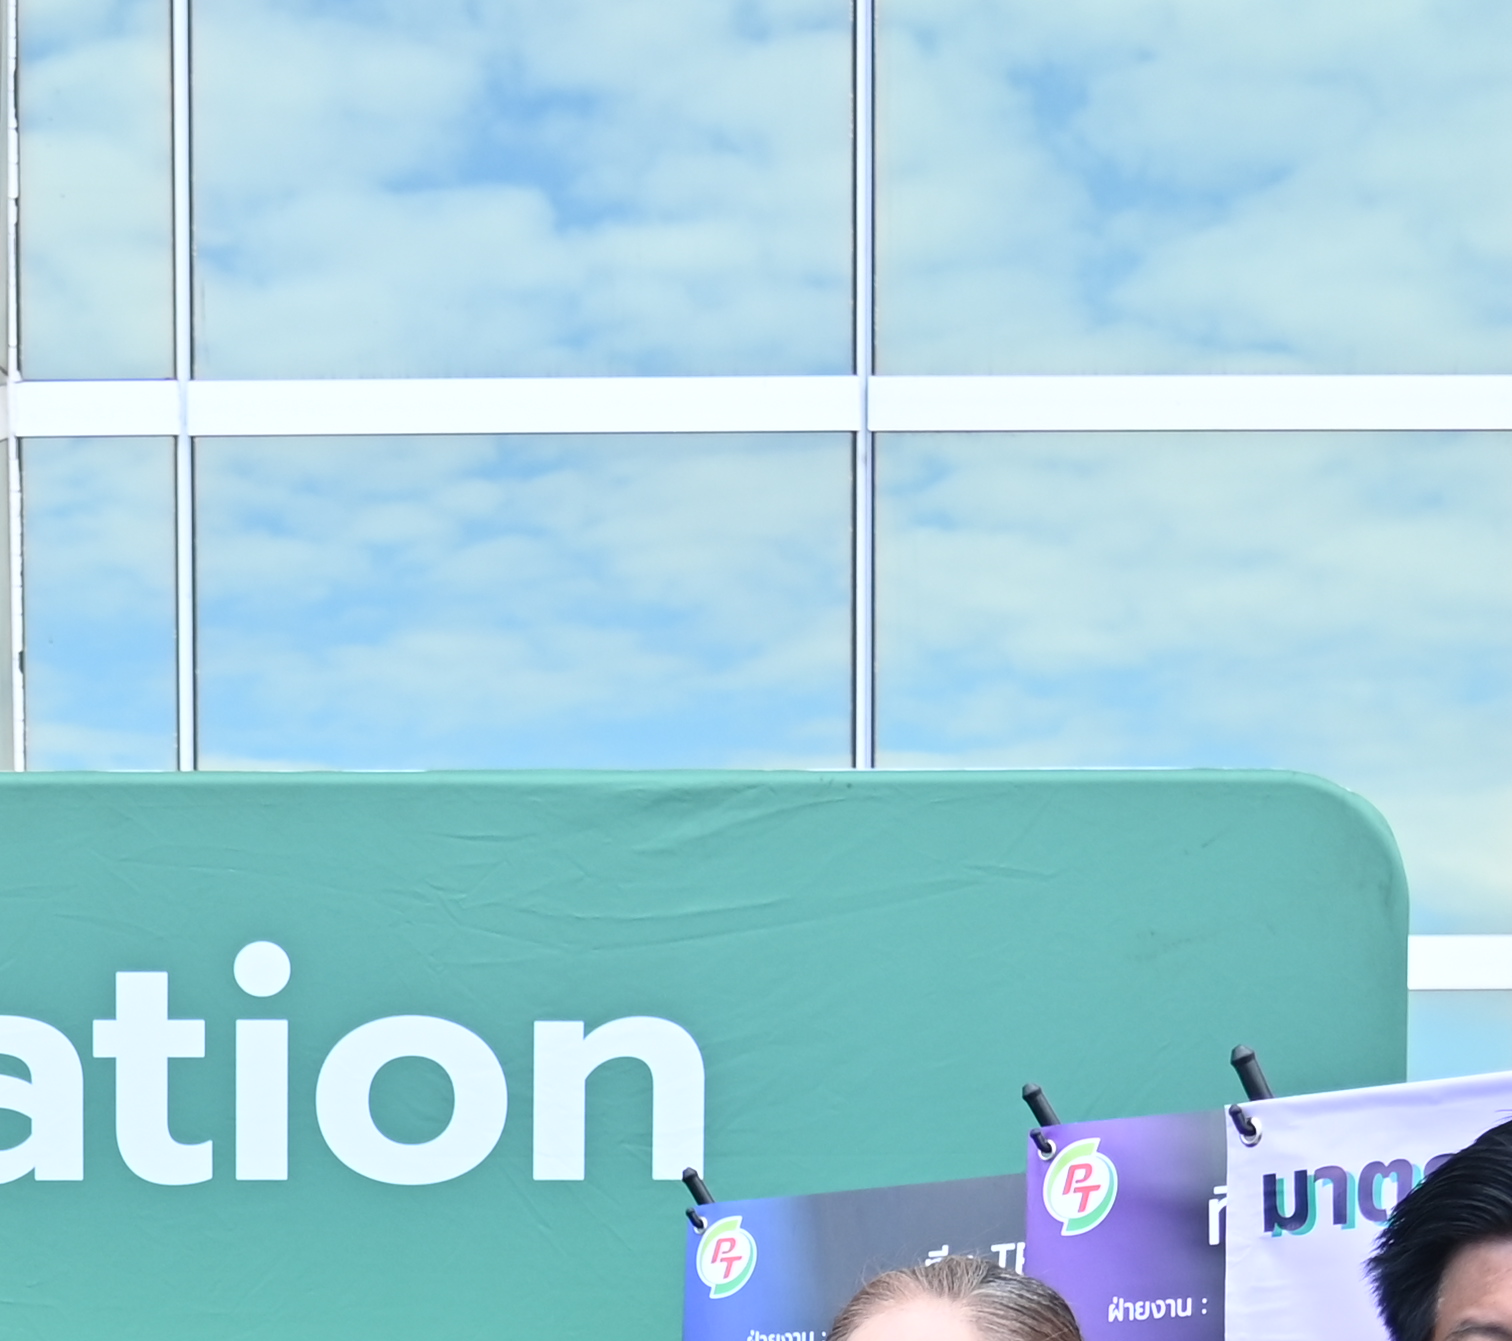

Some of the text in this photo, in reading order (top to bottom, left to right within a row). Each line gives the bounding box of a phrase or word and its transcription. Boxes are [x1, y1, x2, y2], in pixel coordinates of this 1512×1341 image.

[1062, 1163, 1100, 1213] PT
[710, 1237, 743, 1280] PT
[1108, 1296, 1193, 1322] ฝ่ายงาน
